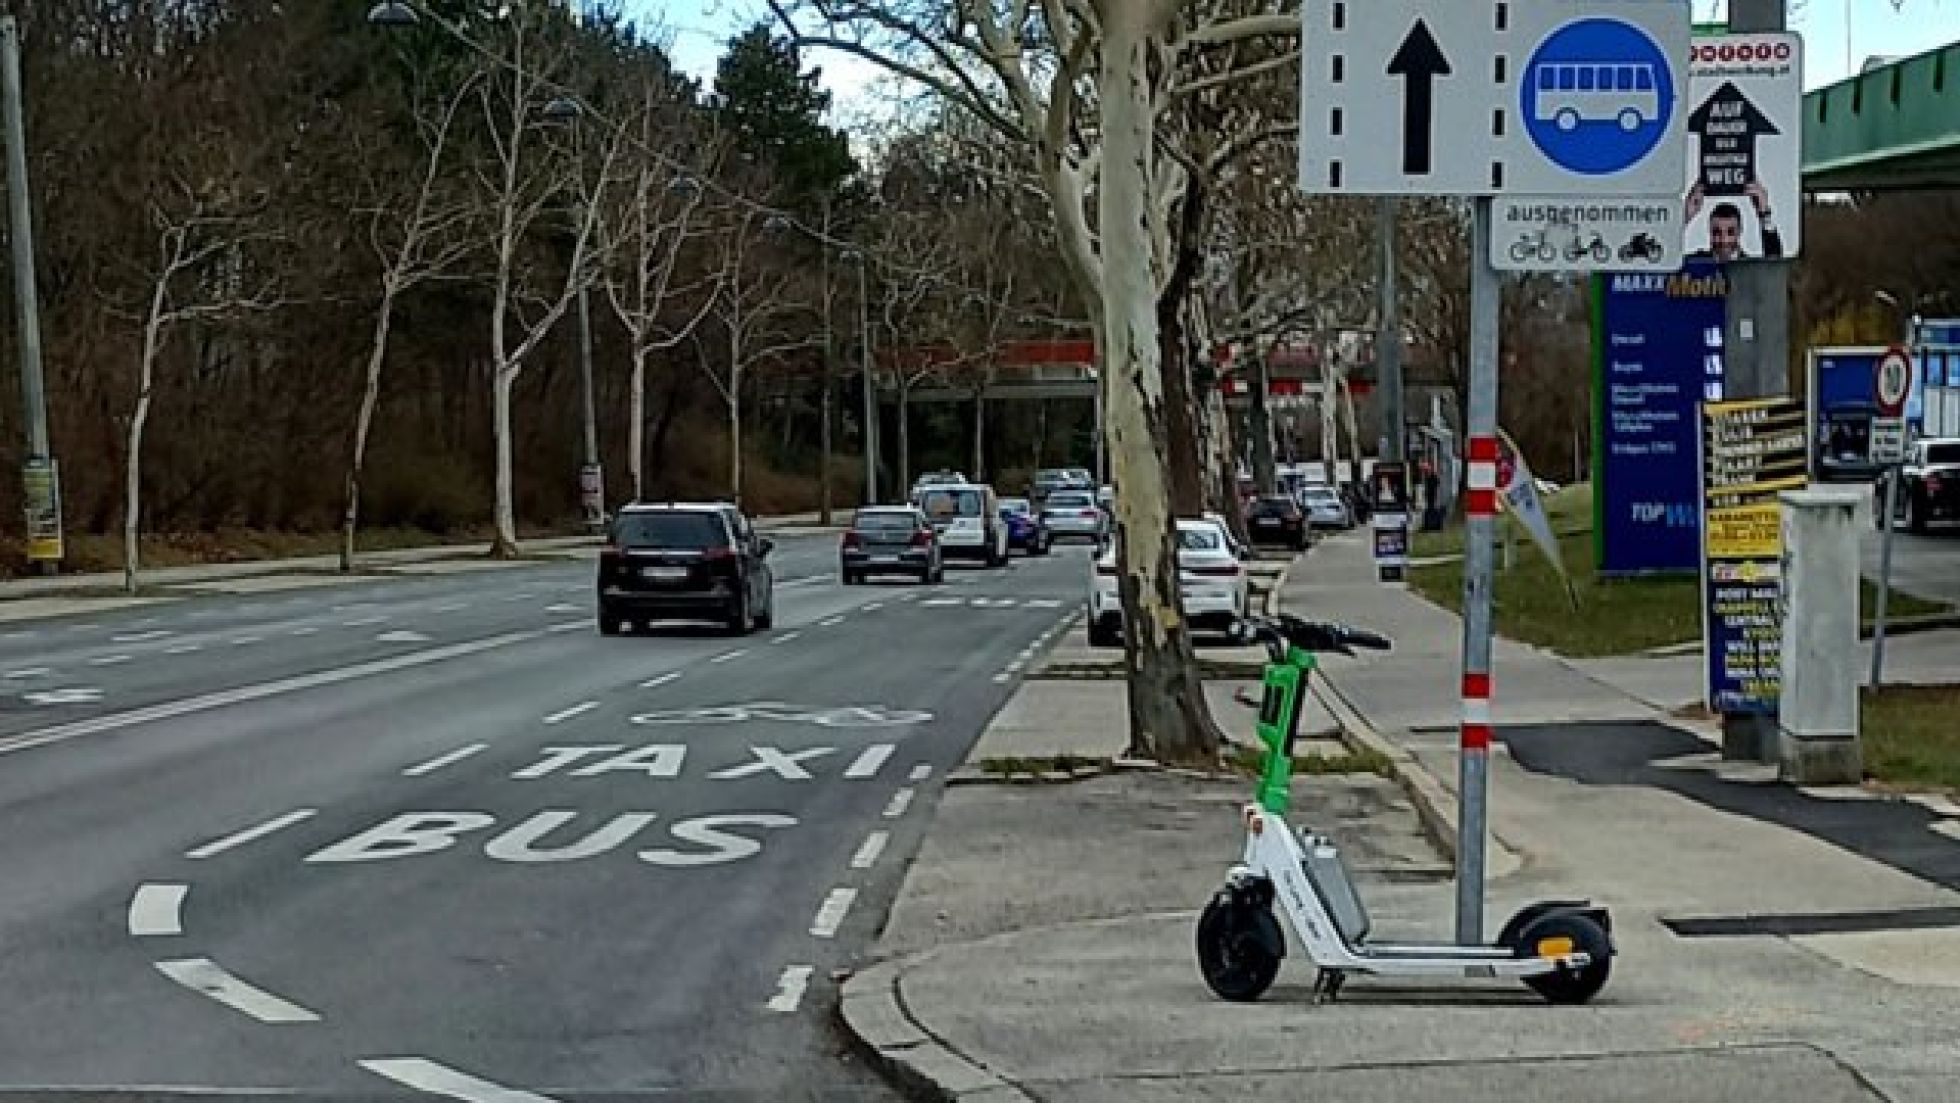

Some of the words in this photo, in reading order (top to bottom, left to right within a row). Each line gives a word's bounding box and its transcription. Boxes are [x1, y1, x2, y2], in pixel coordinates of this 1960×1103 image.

[1706, 168, 1745, 184] WEG
[1507, 204, 1669, 226] ausgenommen
[509, 742, 897, 779] TAXI
[303, 810, 798, 865] BUS
